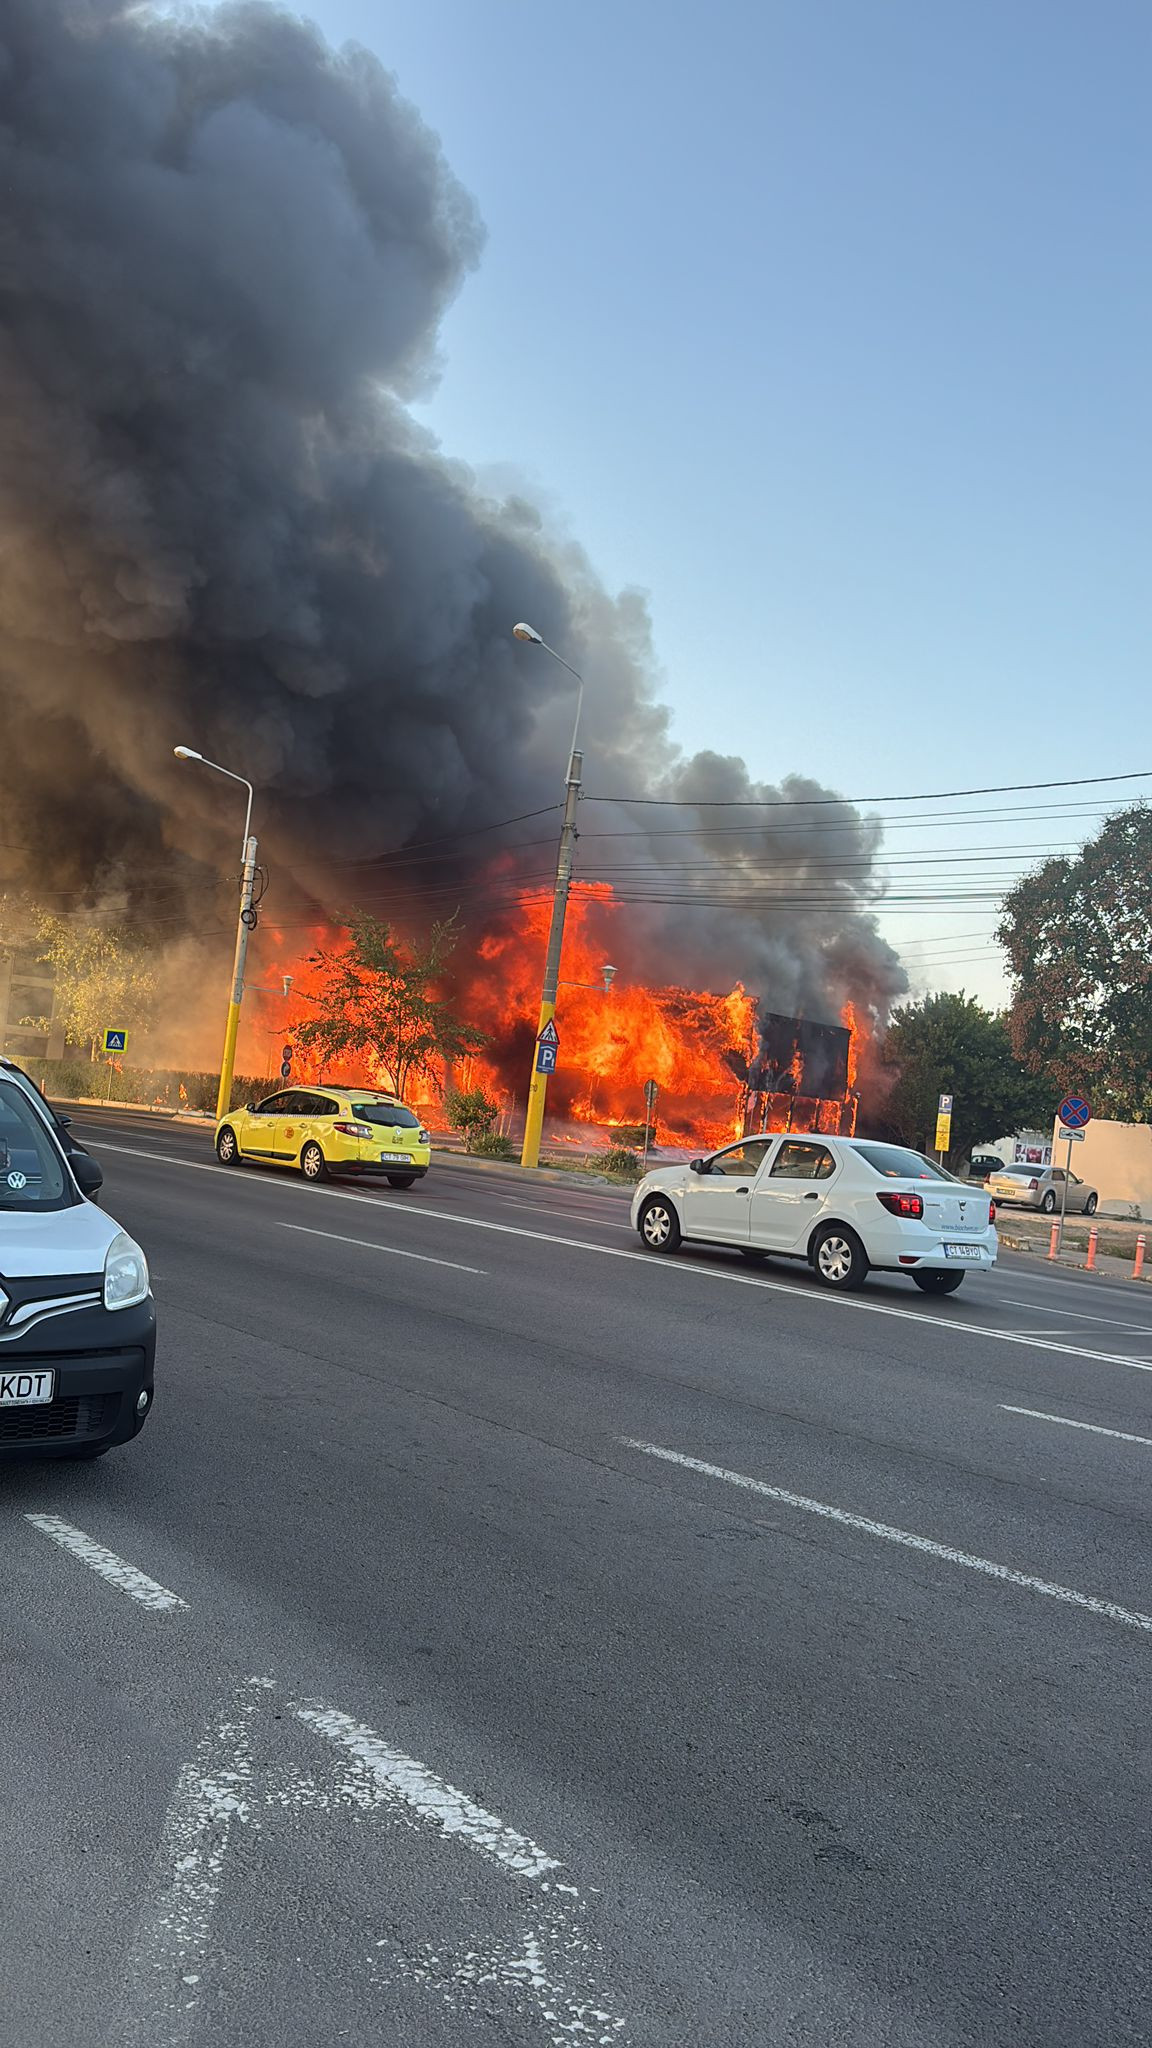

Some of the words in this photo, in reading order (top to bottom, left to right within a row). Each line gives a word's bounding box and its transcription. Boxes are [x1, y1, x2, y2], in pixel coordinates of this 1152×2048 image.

[542, 1050, 553, 1065] P
[942, 1096, 950, 1108] P
[949, 1246, 957, 1255] CT
[0, 1375, 46, 1398] KDT
